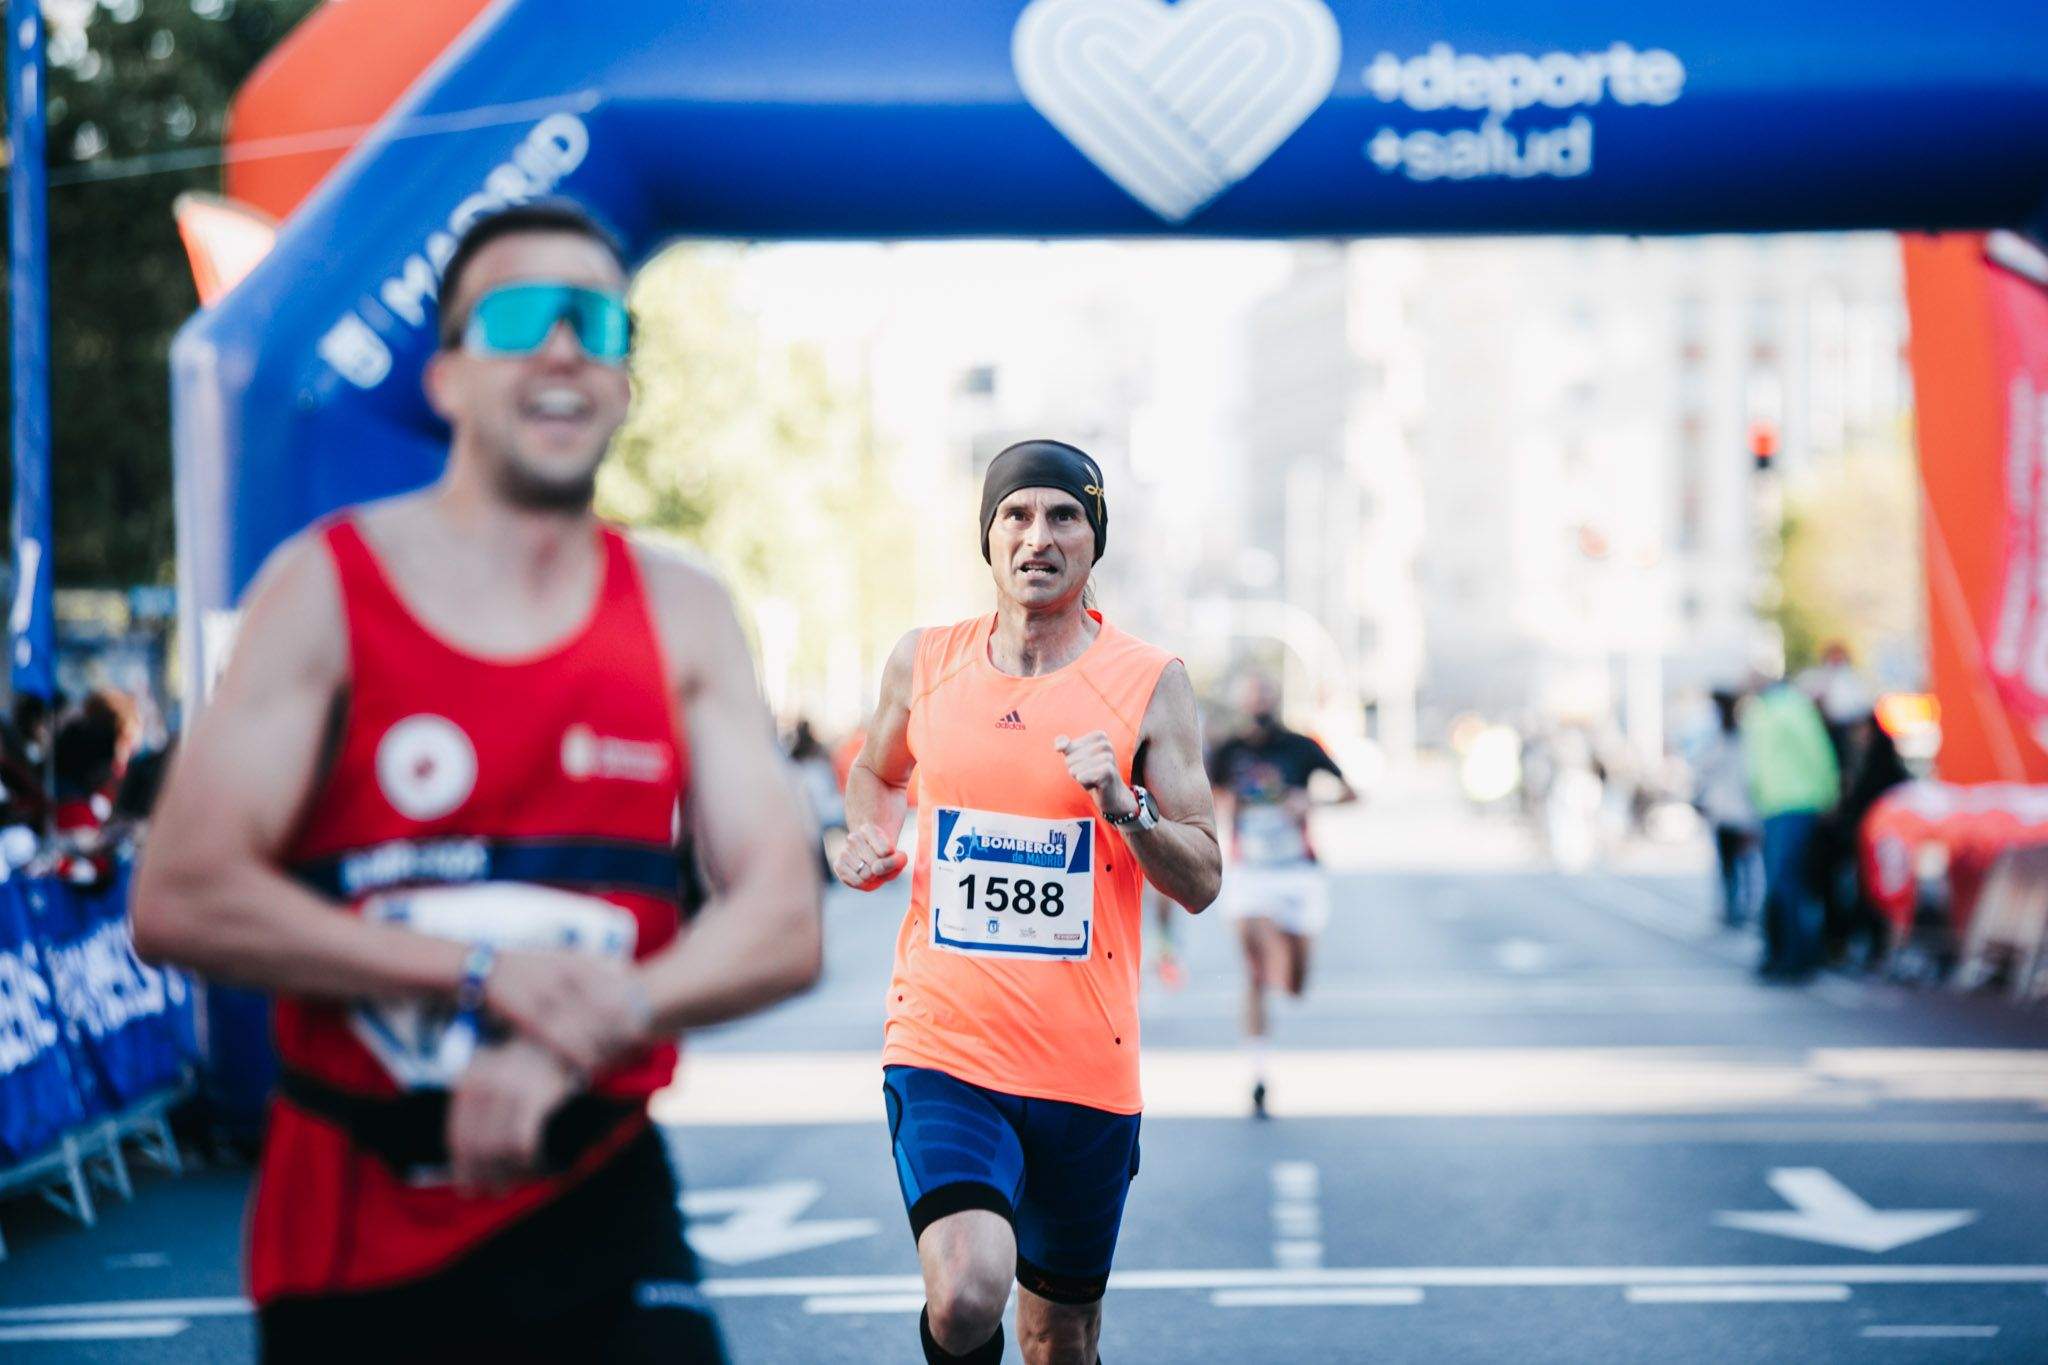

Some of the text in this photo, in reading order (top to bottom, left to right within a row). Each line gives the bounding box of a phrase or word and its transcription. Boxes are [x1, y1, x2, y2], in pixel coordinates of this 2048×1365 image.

[995, 722, 1026, 731] adidas
[981, 836, 1064, 855] BOMBEROS
[1026, 852, 1064, 867] MADRID
[958, 874, 1064, 917] 1588
